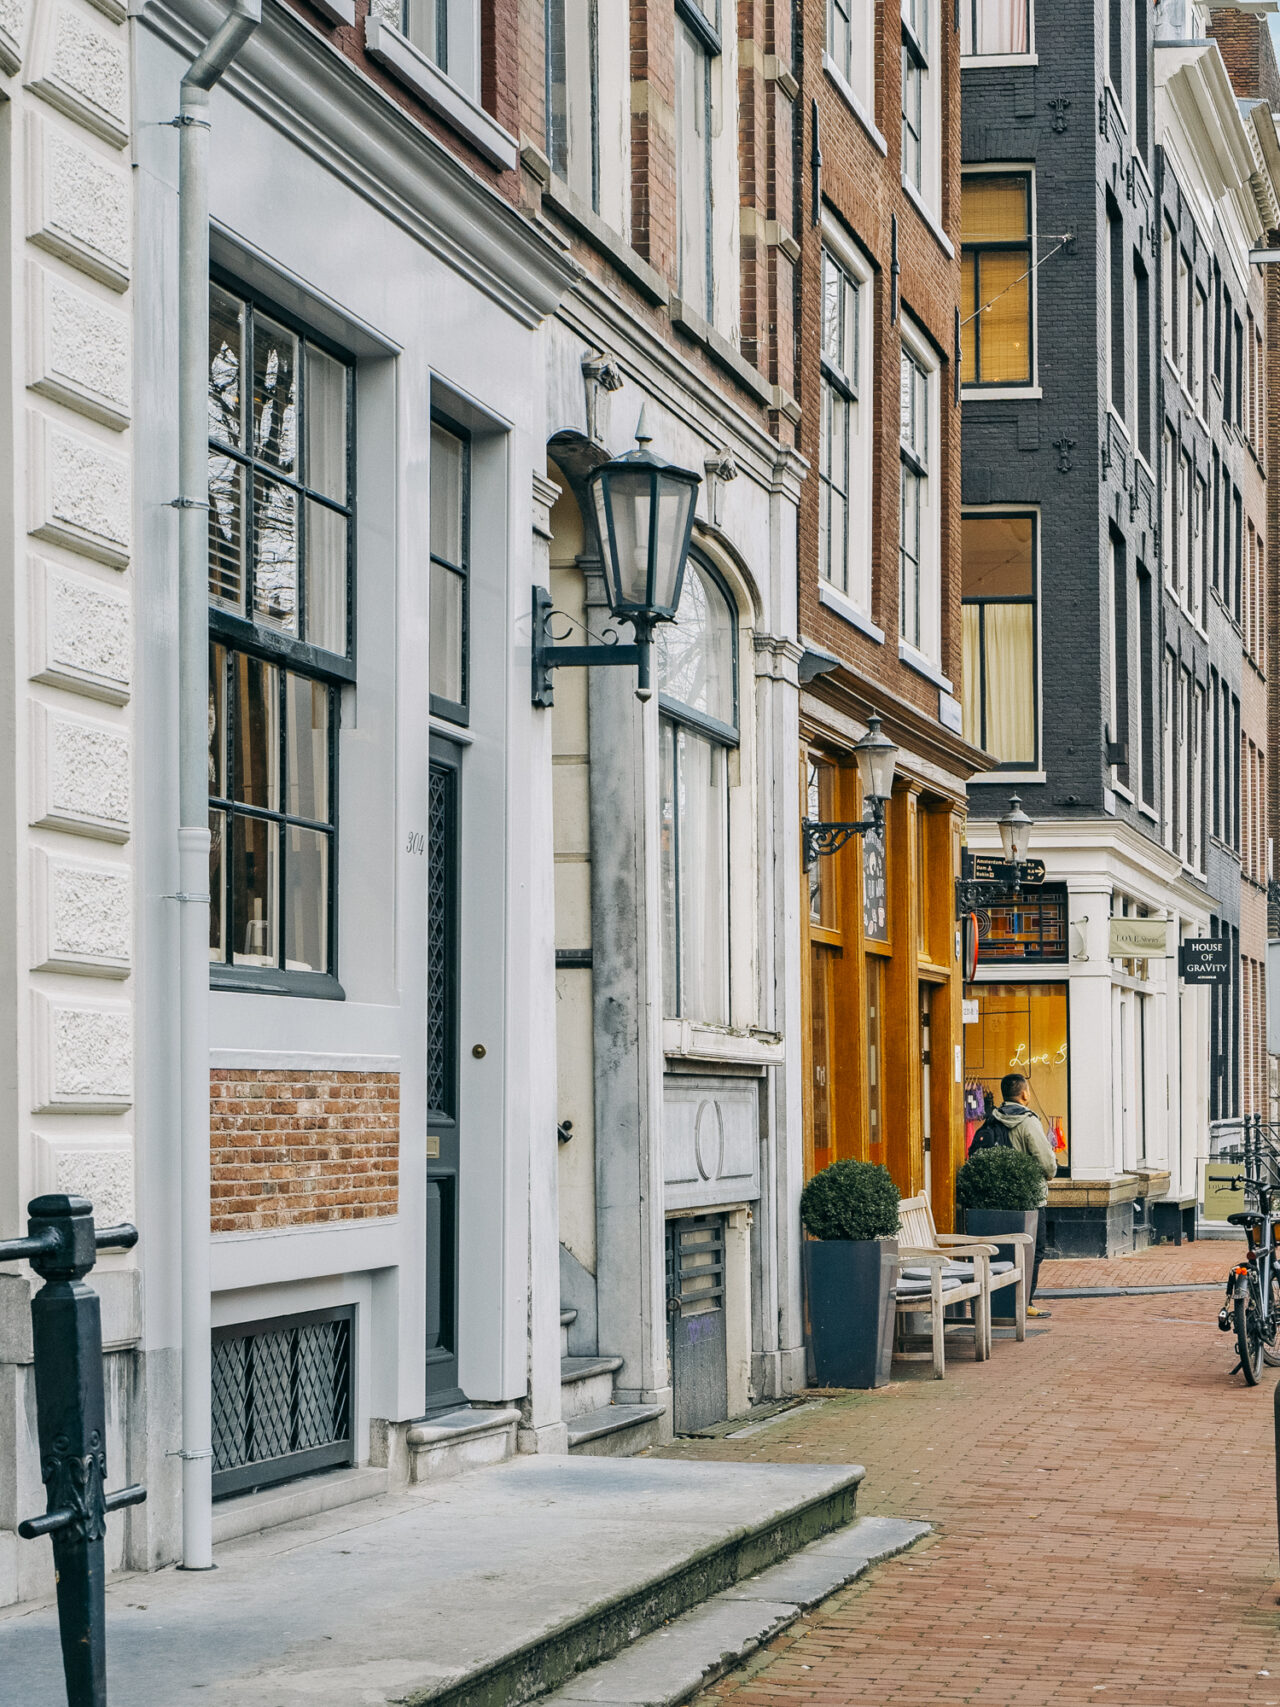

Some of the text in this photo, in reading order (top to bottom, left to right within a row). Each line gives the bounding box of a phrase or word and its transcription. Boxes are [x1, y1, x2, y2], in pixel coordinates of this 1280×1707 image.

[406, 831, 424, 855] 304
[1191, 943, 1223, 951] HOUSE
[1201, 953, 1214, 961] OF
[1186, 963, 1227, 972] GRAVITY
[1009, 1044, 1050, 1067] Love
